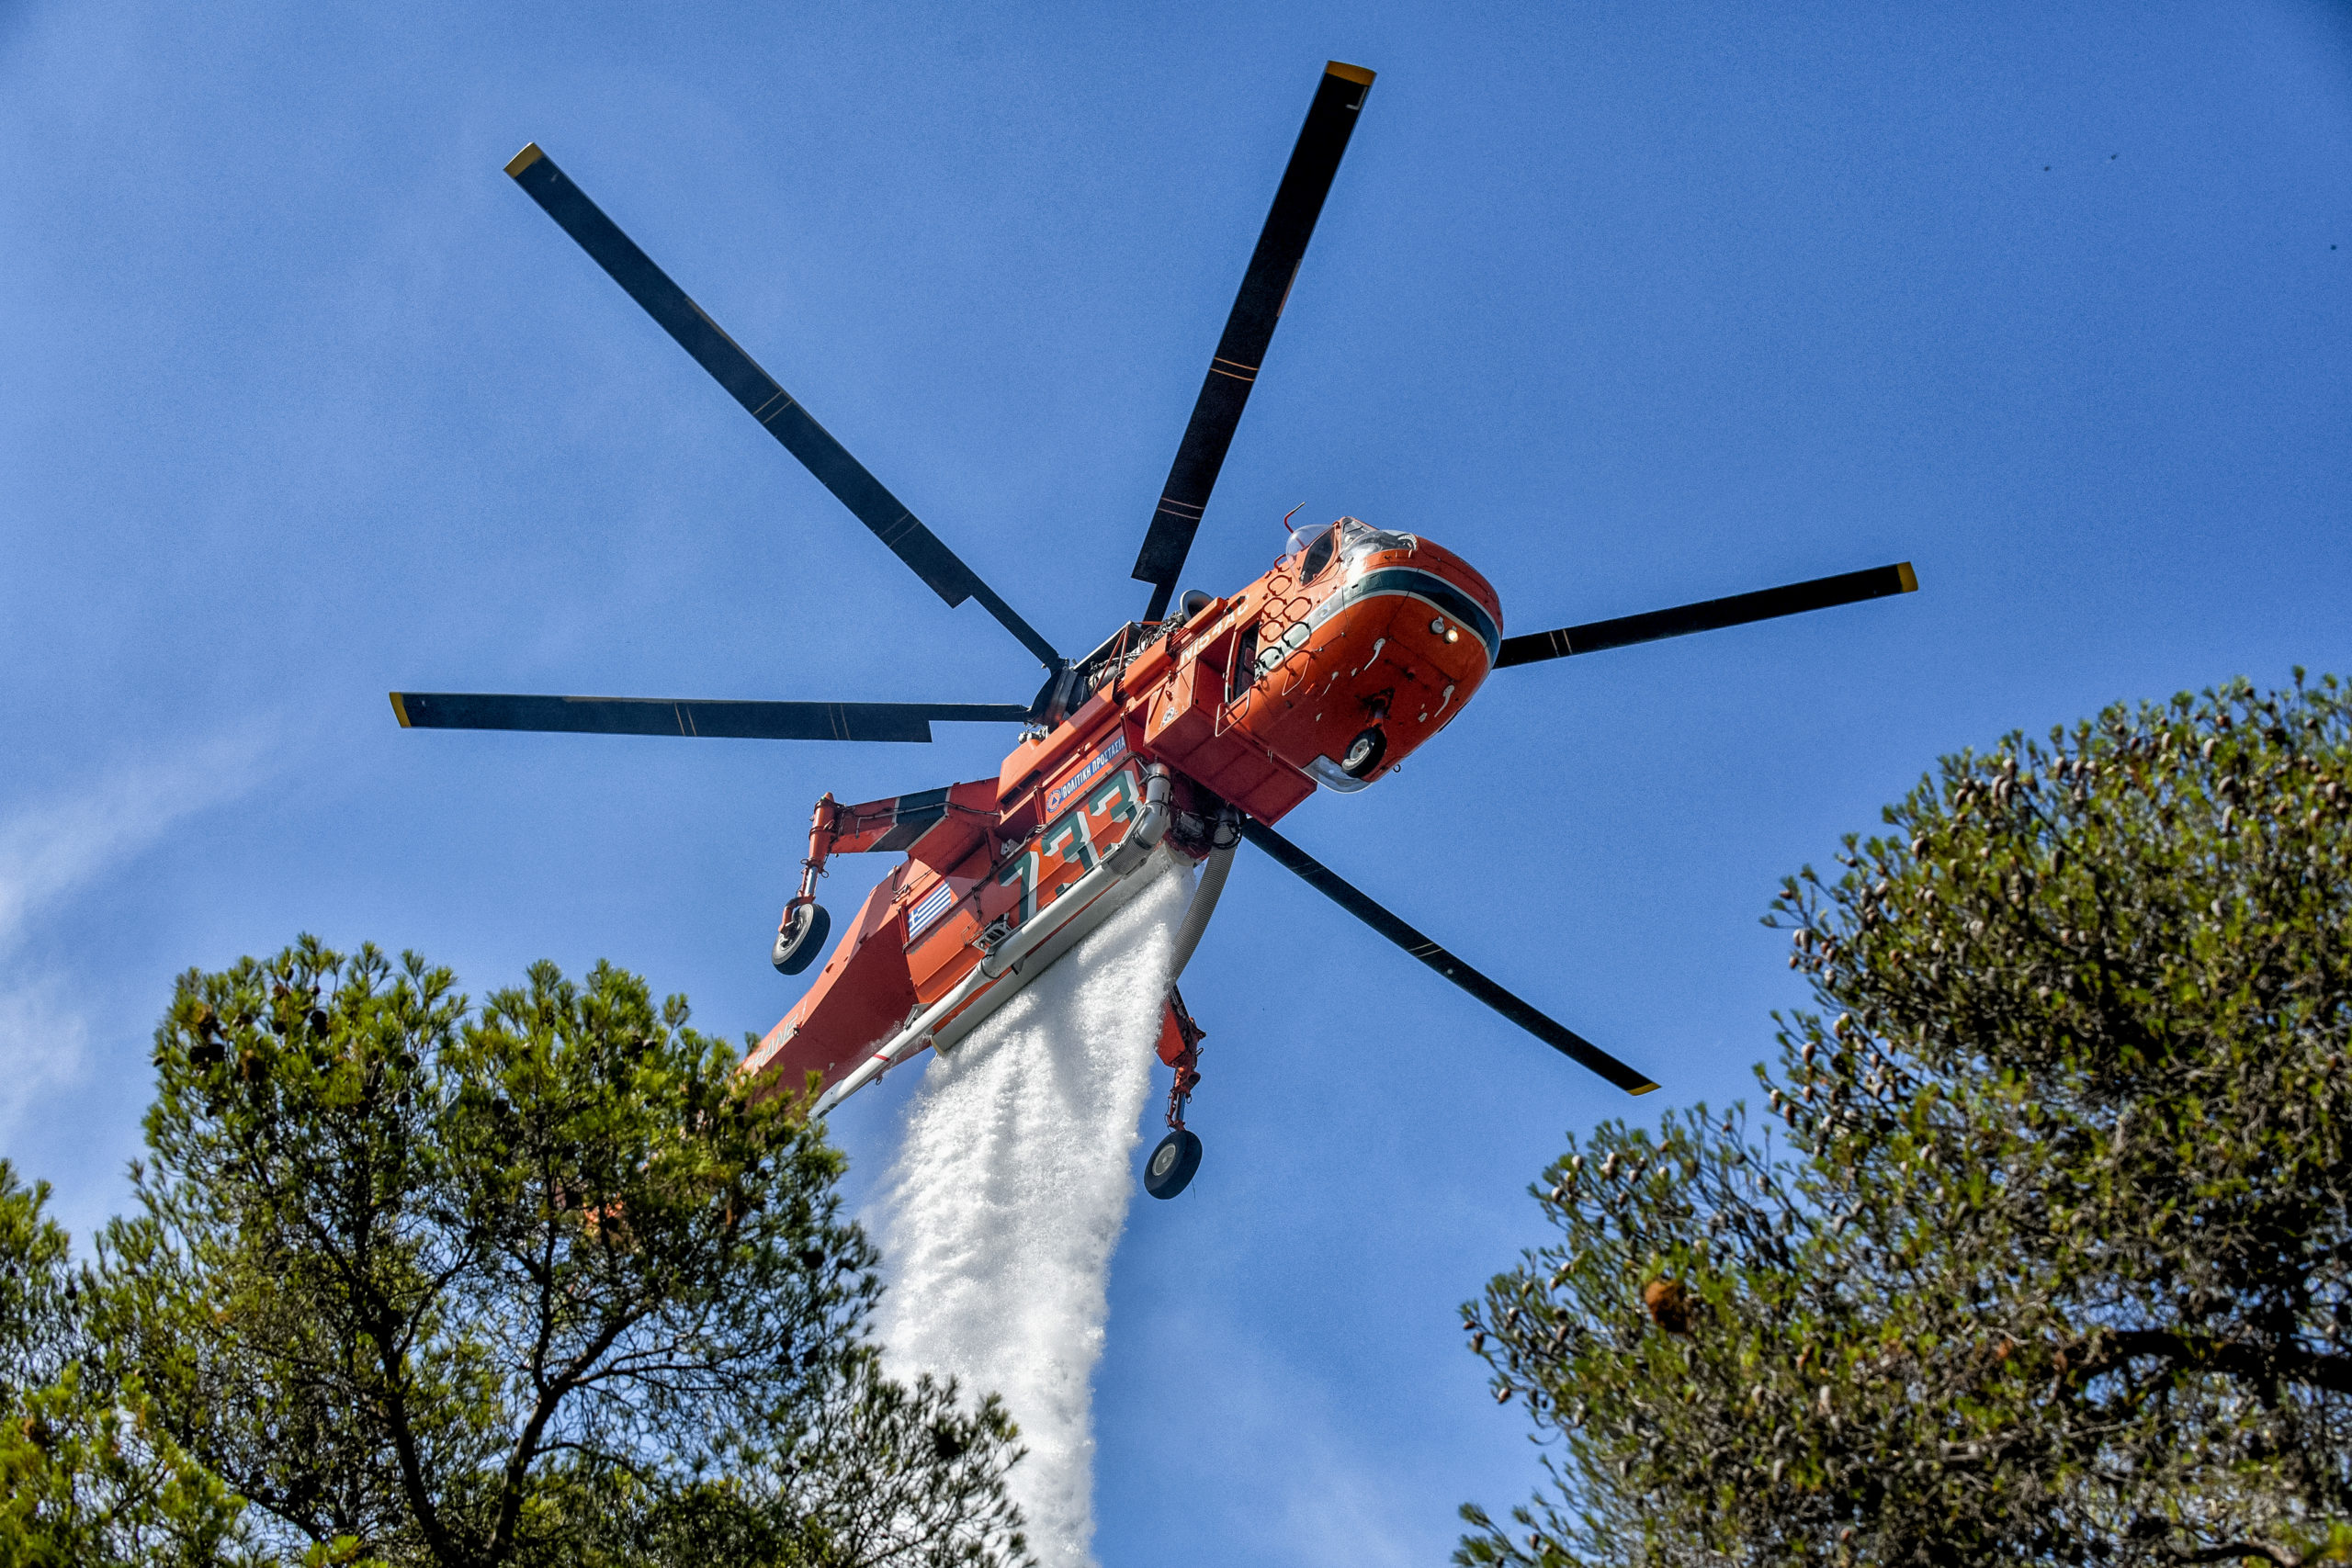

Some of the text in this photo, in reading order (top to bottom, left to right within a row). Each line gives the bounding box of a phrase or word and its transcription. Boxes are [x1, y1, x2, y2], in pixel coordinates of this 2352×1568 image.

[1062, 738, 1125, 798] ΠΟΛΙΤΙΚΗ ΠΡΟΣΤΑΣΙΑ
[999, 770, 1145, 924] 733
